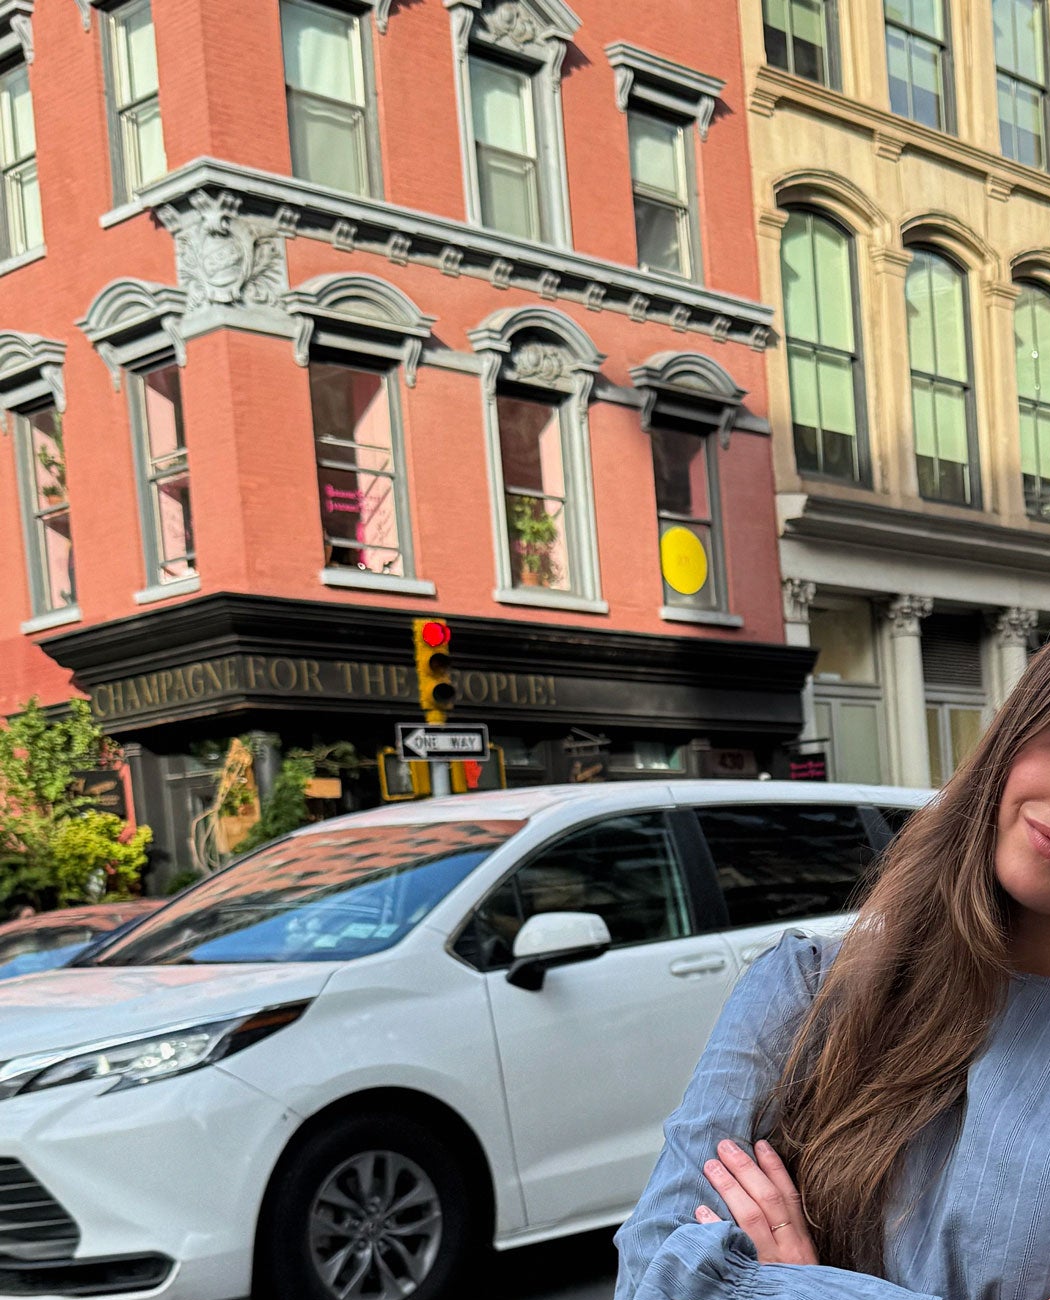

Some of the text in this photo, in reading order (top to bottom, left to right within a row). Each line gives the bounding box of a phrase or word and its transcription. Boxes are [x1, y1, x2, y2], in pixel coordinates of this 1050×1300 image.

[91, 655, 557, 717] CHAMPAGNE FOR THE EOPLE!
[415, 735, 477, 751] ONE WAY
